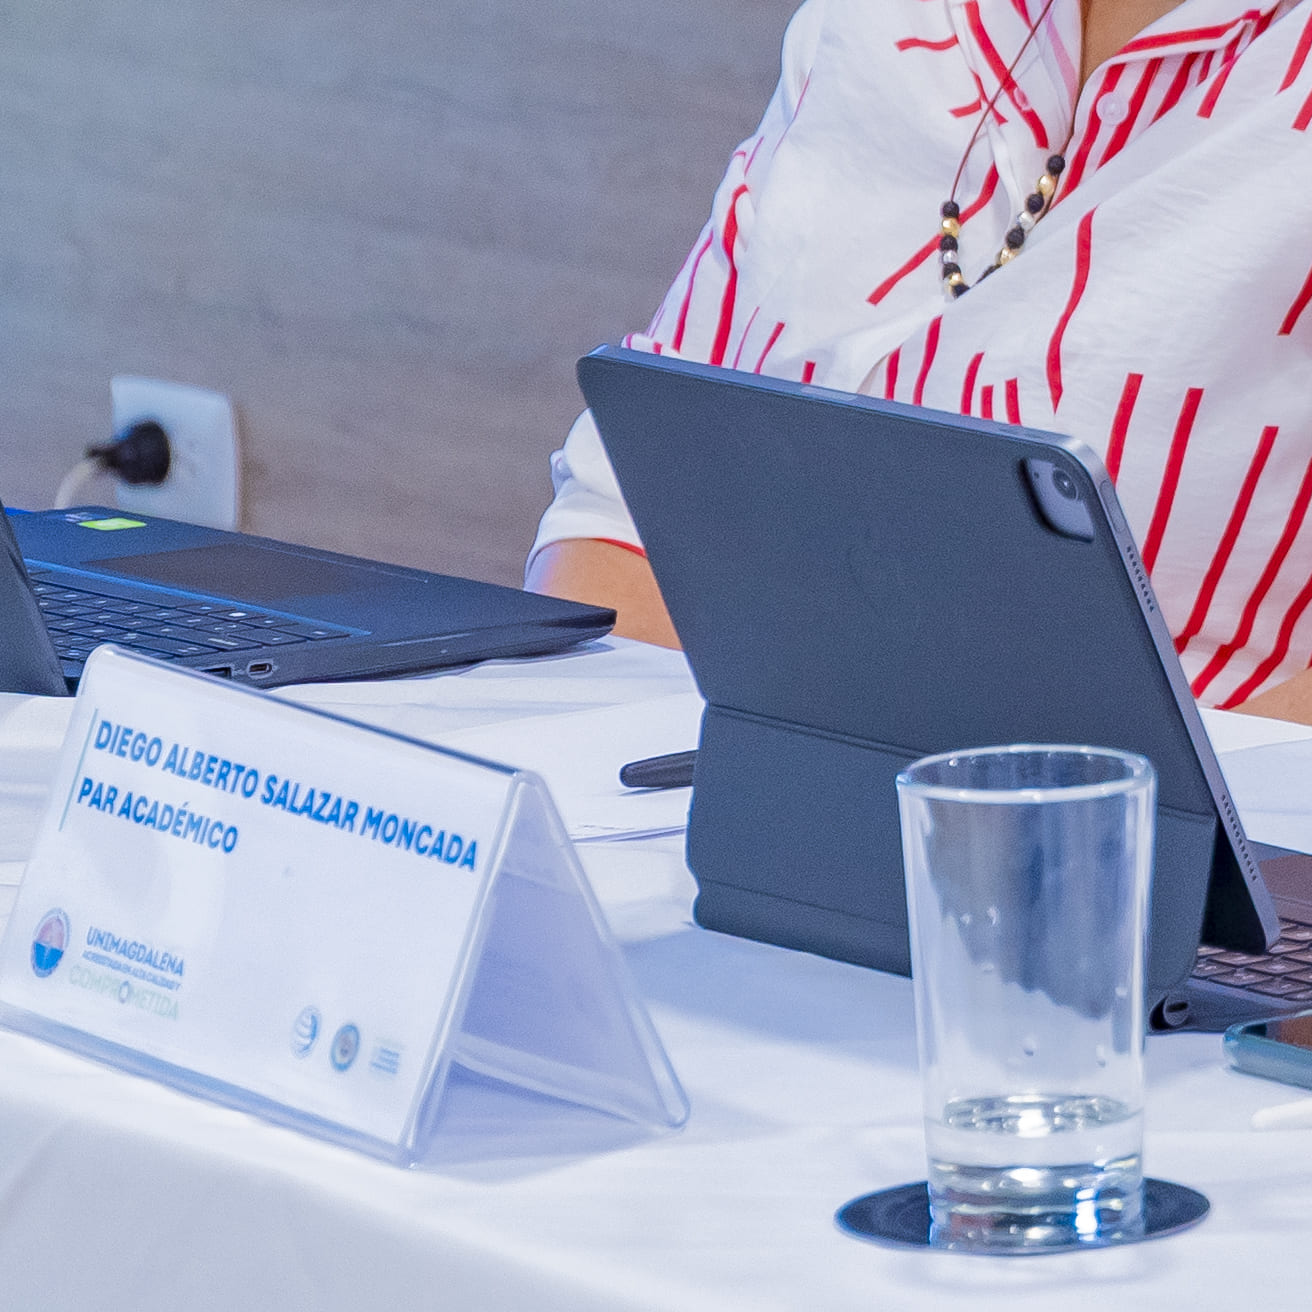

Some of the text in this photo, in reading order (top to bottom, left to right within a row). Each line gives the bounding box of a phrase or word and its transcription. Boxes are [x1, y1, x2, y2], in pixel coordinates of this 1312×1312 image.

[77, 777, 238, 853] PAR ACADÉMICO
[94, 720, 477, 872] DIEGO ALBERTO SALAZAR MONCADA
[86, 926, 184, 976] UNIMAGDALENA
